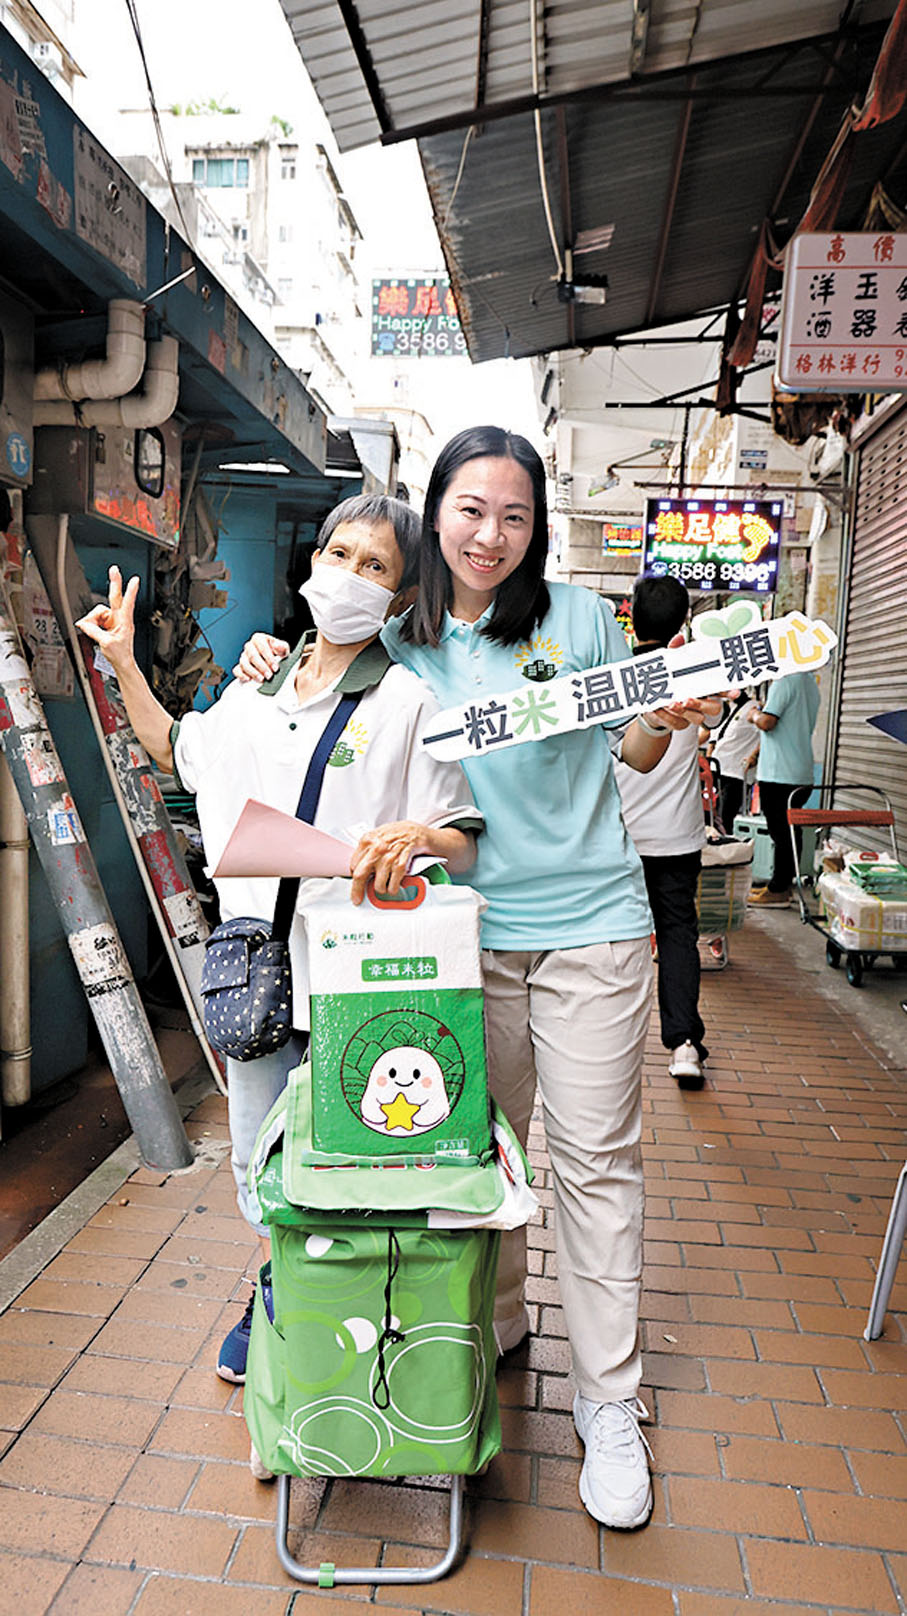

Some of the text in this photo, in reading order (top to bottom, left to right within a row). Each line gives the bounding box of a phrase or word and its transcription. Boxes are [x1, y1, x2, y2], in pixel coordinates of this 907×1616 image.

[378, 315, 461, 333] Happy Fo
[396, 332, 468, 351] 3586 9
[796, 353, 881, 374] 格林洋行
[655, 511, 741, 543] 樂足健
[652, 542, 703, 562] Happy
[667, 562, 717, 581] 3586
[422, 688, 560, 750] 一粒米
